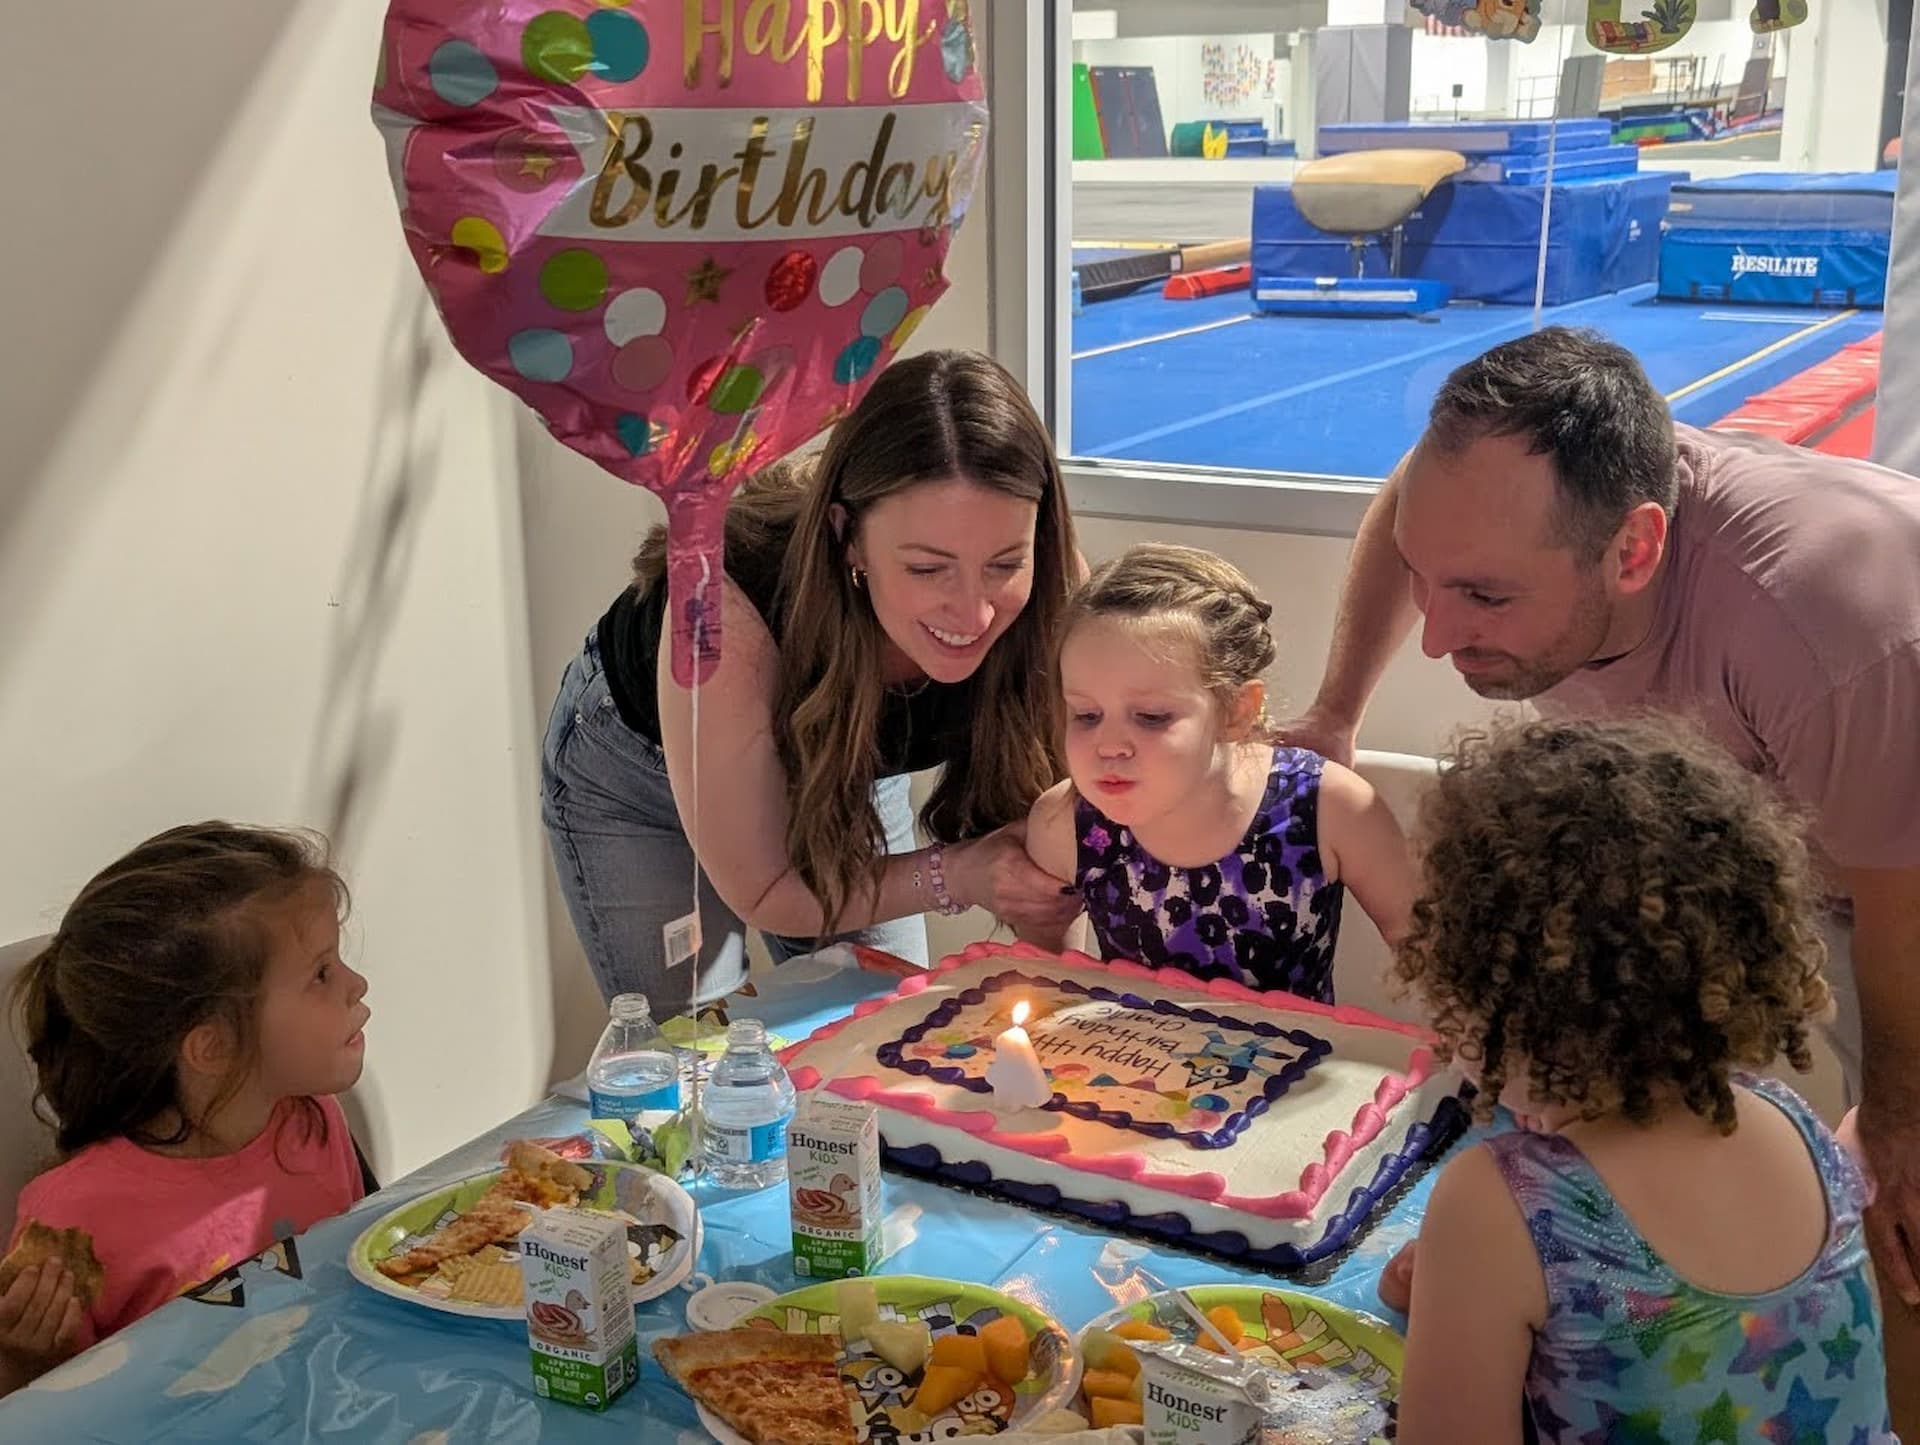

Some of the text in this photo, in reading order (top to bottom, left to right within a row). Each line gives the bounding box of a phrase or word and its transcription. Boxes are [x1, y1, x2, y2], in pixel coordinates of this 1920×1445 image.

[683, 0, 936, 103] Happy
[588, 111, 956, 245] Birthday
[1731, 254, 1818, 275] RESILITE
[1057, 1013, 1182, 1051] Birthday
[1081, 1039, 1171, 1078] Happy
[790, 1132, 858, 1156] Honest
[799, 1225, 856, 1240] ORGANIC
[524, 1241, 589, 1272] Honest
[535, 1341, 593, 1361] ORGANIC
[1146, 1381, 1229, 1424] Honest
